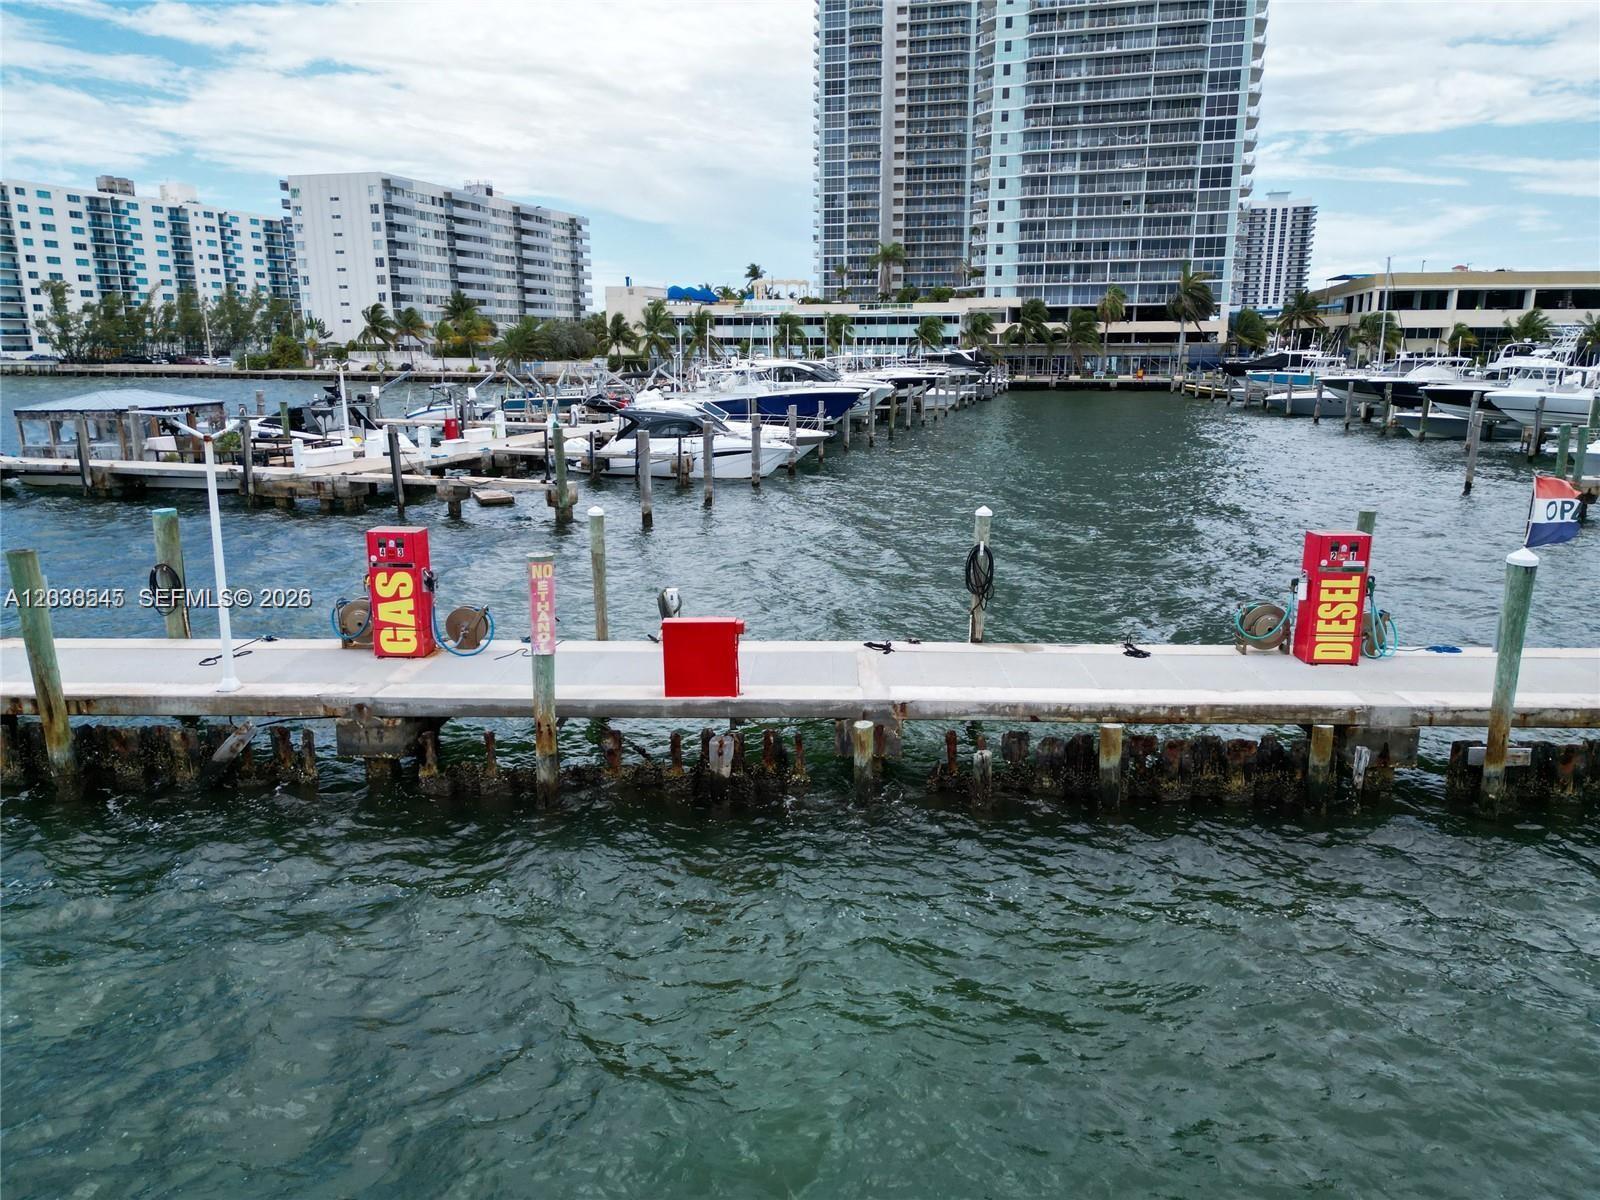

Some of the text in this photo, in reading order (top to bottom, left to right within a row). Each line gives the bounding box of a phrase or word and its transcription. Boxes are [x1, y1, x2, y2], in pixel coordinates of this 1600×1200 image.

[1546, 500, 1579, 521] OP
[1331, 552, 1337, 560] 2
[1350, 552, 1356, 560] 1
[531, 564, 553, 579] NO
[375, 571, 418, 654] GAS
[536, 580, 551, 652] ETHANOL
[1313, 576, 1361, 660] DIESEL
